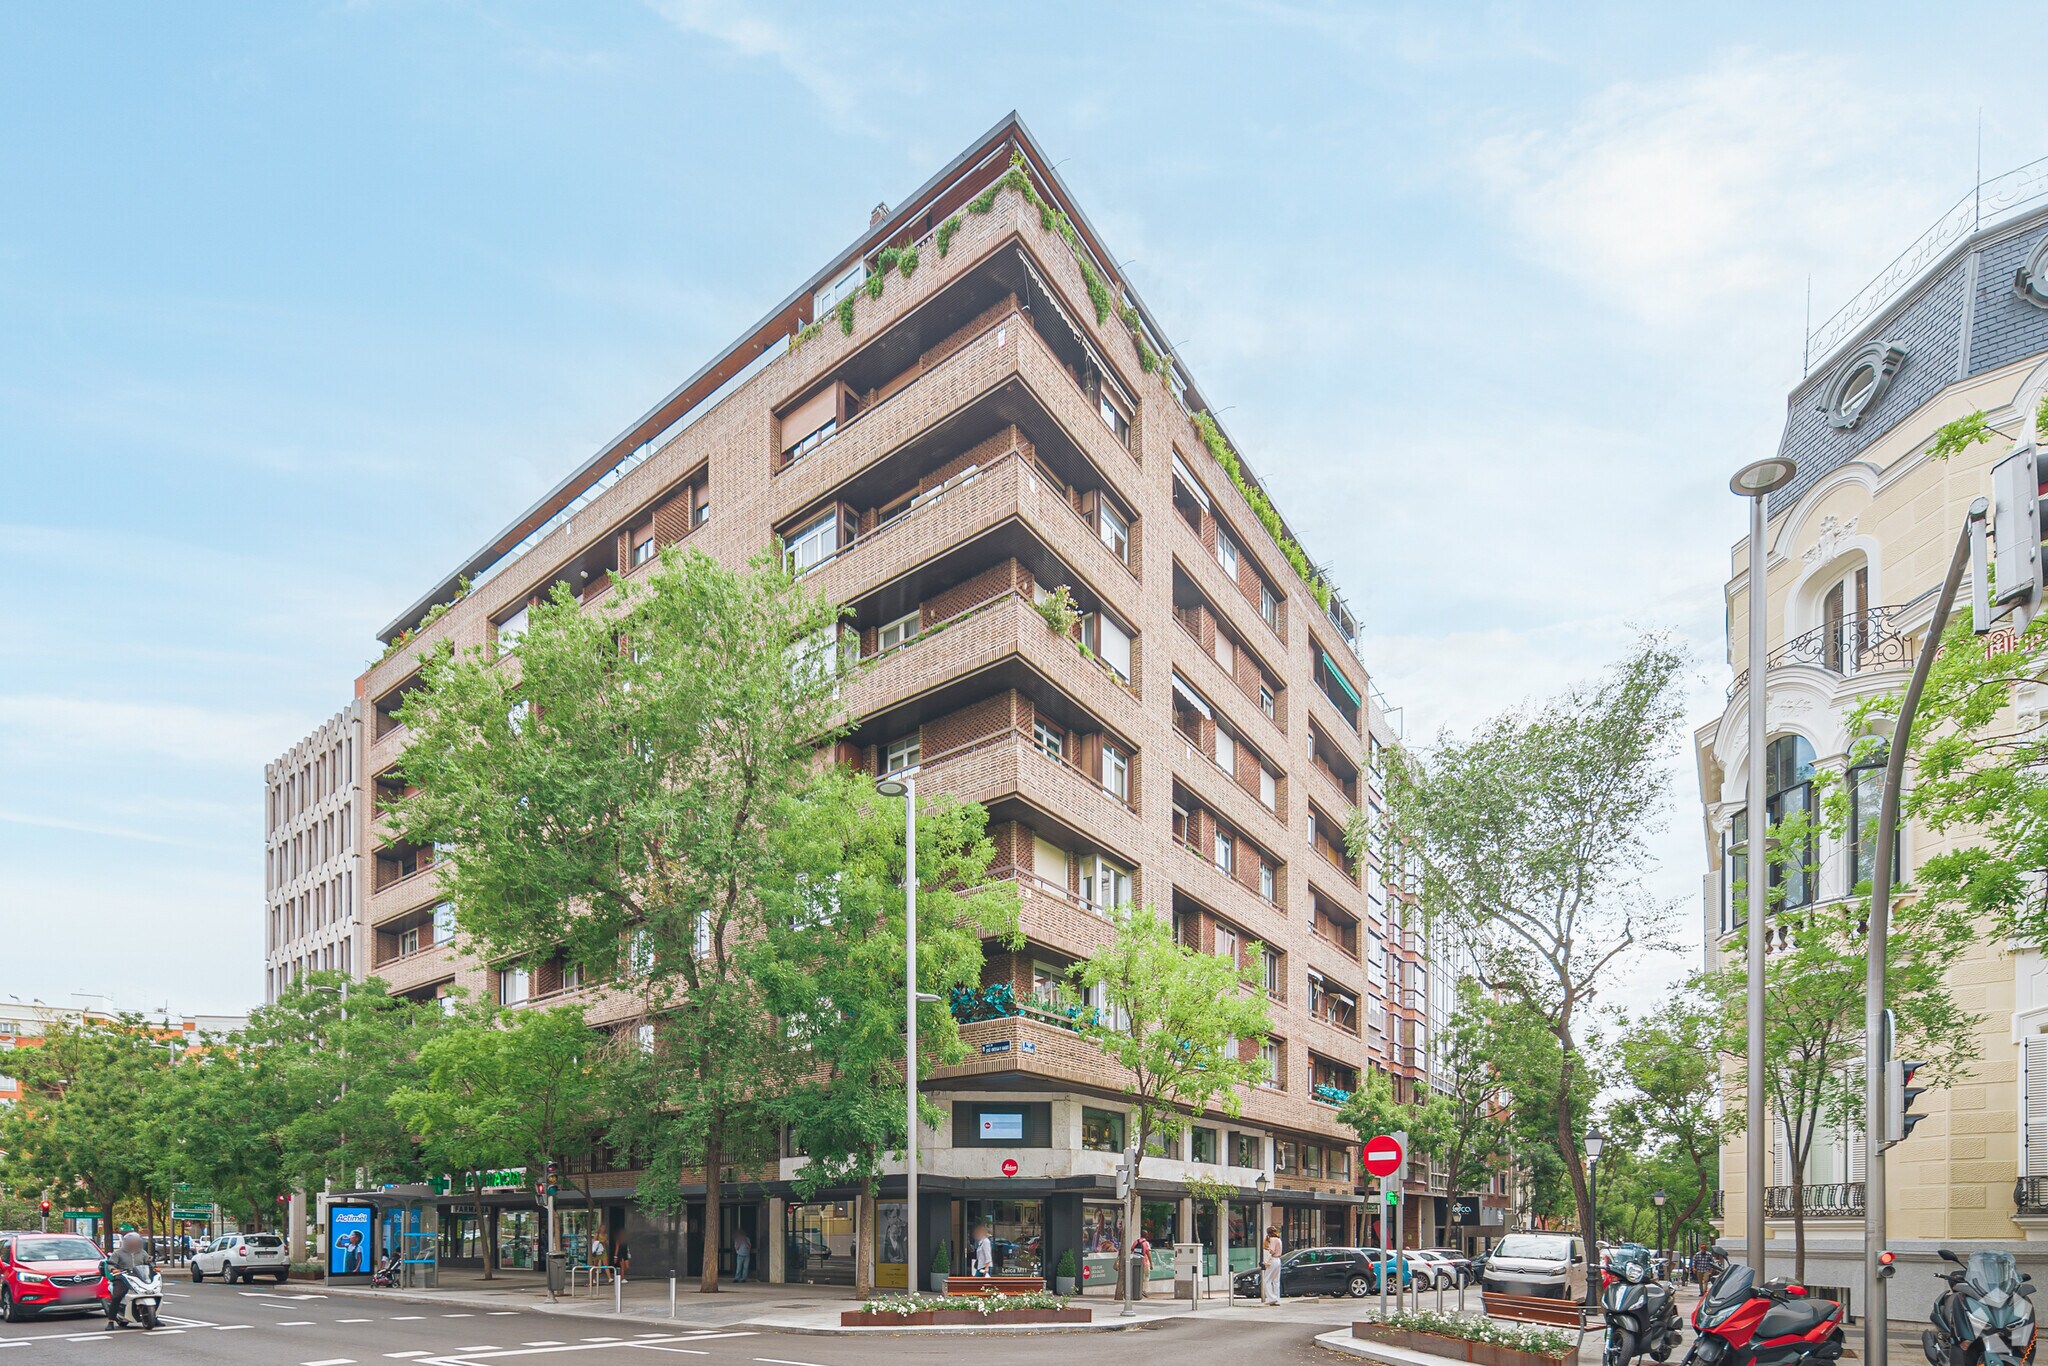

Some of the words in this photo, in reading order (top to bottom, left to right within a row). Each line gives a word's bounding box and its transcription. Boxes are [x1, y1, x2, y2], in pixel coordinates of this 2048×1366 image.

[1003, 1163, 1017, 1171] Leica
[464, 1170, 521, 1187] AMACIA
[336, 1213, 367, 1222] Actimel
